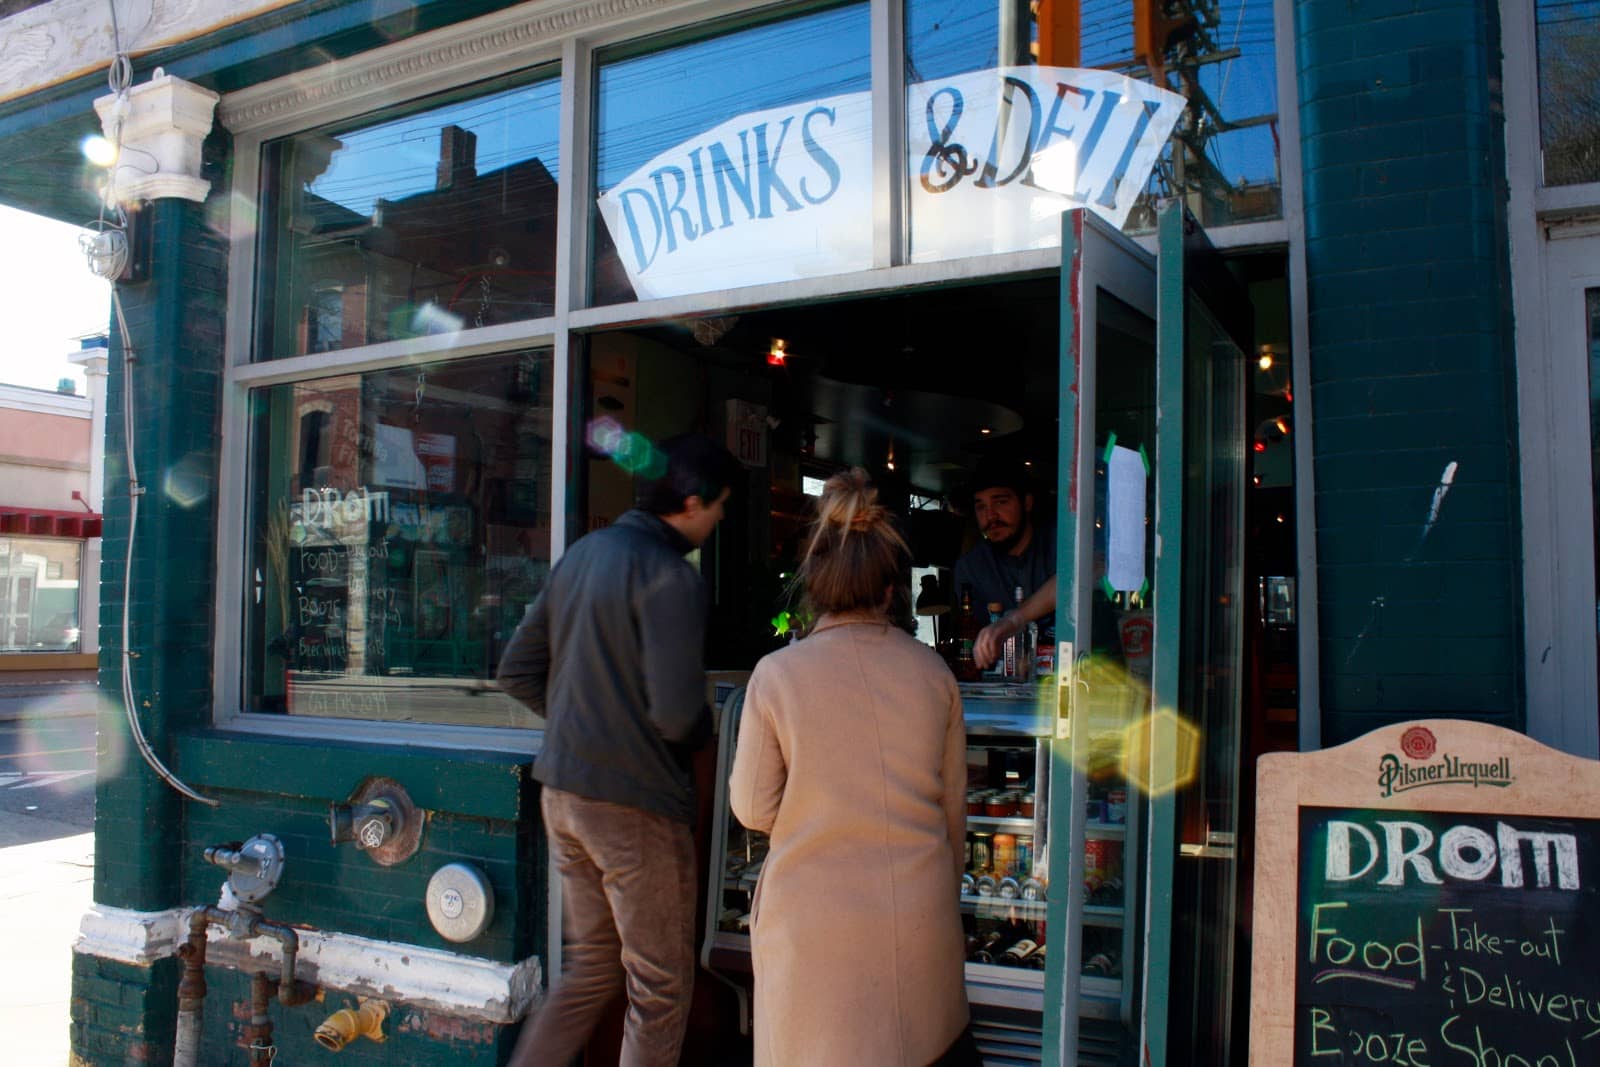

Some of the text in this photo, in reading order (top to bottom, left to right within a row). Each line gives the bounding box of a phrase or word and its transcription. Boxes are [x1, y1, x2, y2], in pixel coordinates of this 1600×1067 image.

[617, 106, 842, 275] DRINKS
[920, 88, 978, 194] &
[1379, 753, 1510, 798] Pilsner Urquell
[1459, 967, 1600, 1040] Delivery
